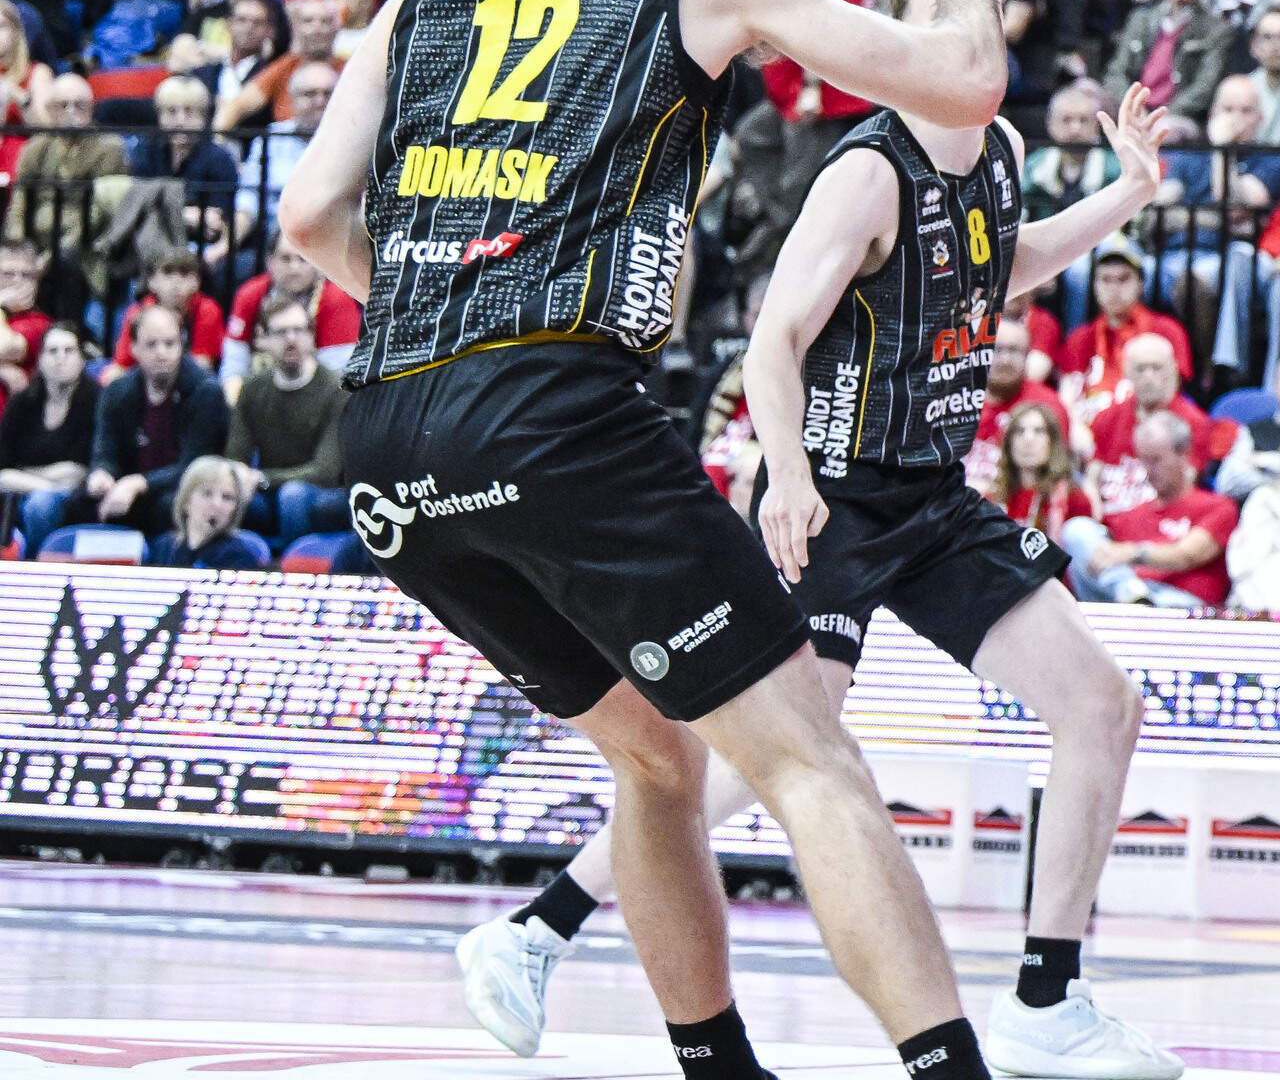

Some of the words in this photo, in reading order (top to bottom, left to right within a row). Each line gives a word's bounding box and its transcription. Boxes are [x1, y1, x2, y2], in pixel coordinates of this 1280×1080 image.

[397, 145, 559, 203] DOMASK
[968, 208, 991, 265] 8
[394, 473, 438, 503] Port
[420, 481, 521, 518] Oostende
[667, 601, 734, 651] BRASSI
[683, 630, 711, 653] GRAND
